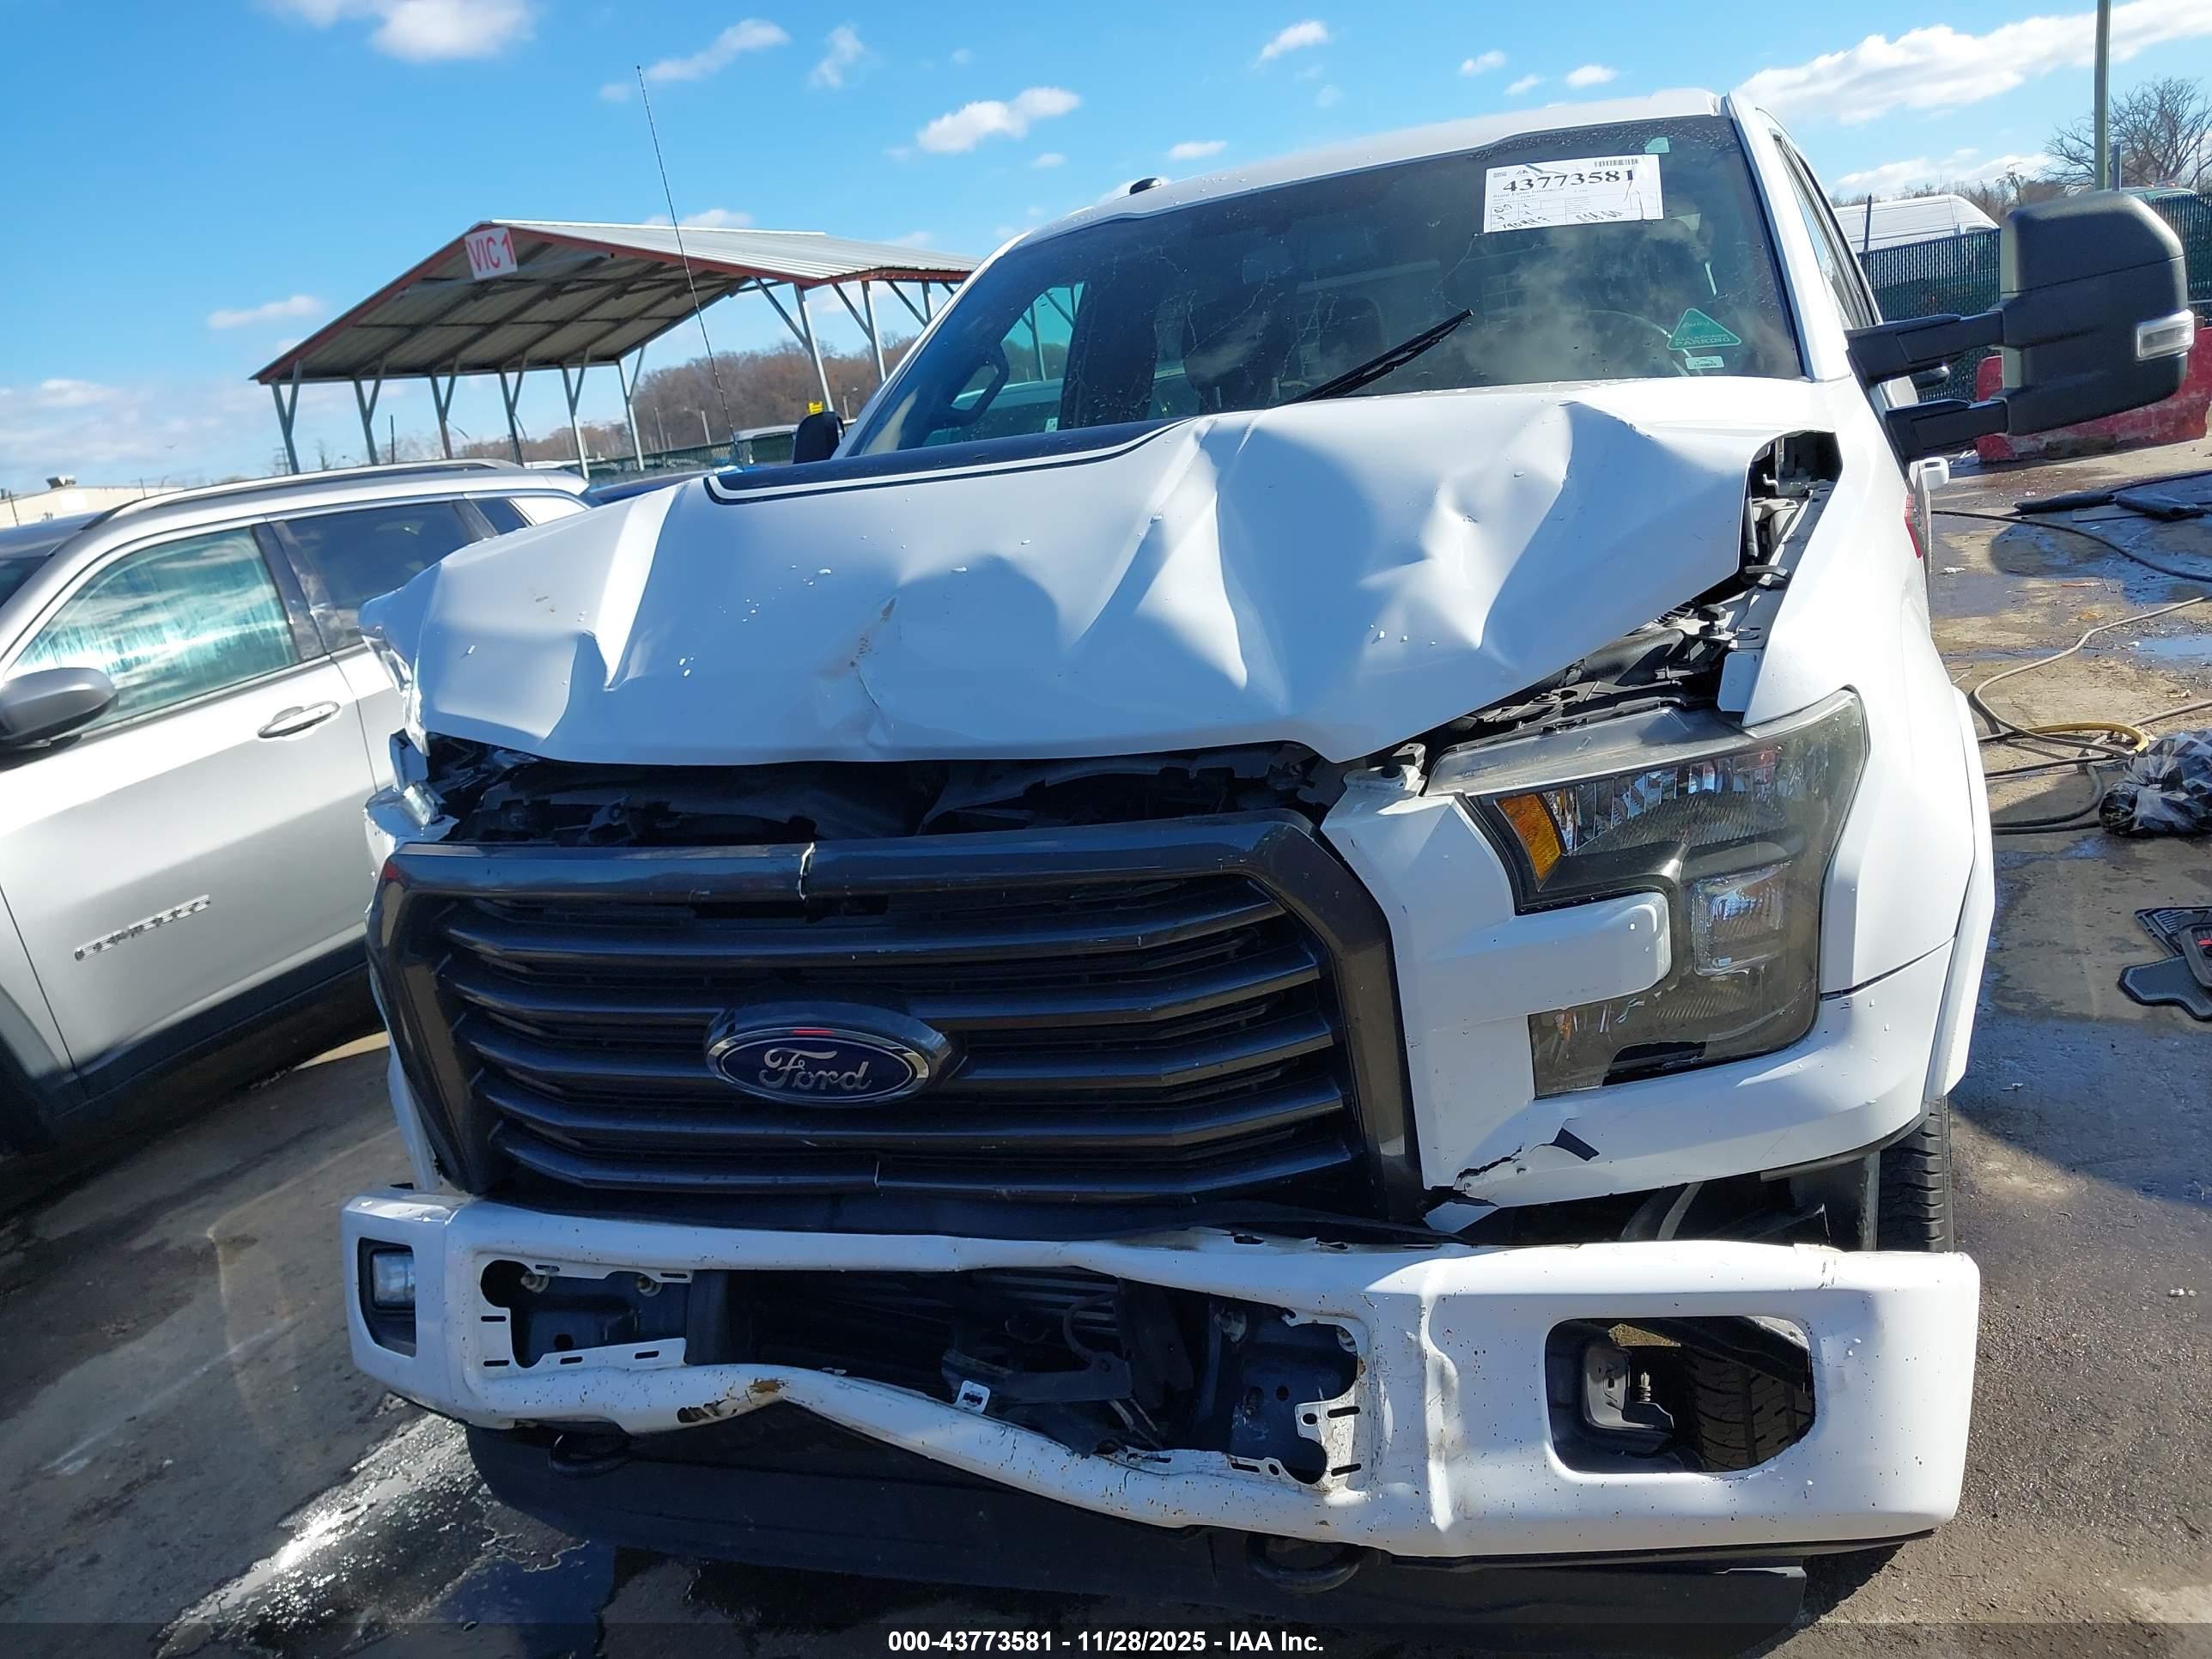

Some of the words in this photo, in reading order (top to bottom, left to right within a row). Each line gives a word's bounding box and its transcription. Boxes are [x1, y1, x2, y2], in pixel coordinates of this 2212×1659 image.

[1503, 168, 1635, 191] 43773581
[467, 235, 501, 273] VIC
[501, 232, 515, 265] 1
[758, 1047, 872, 1091] Ford
